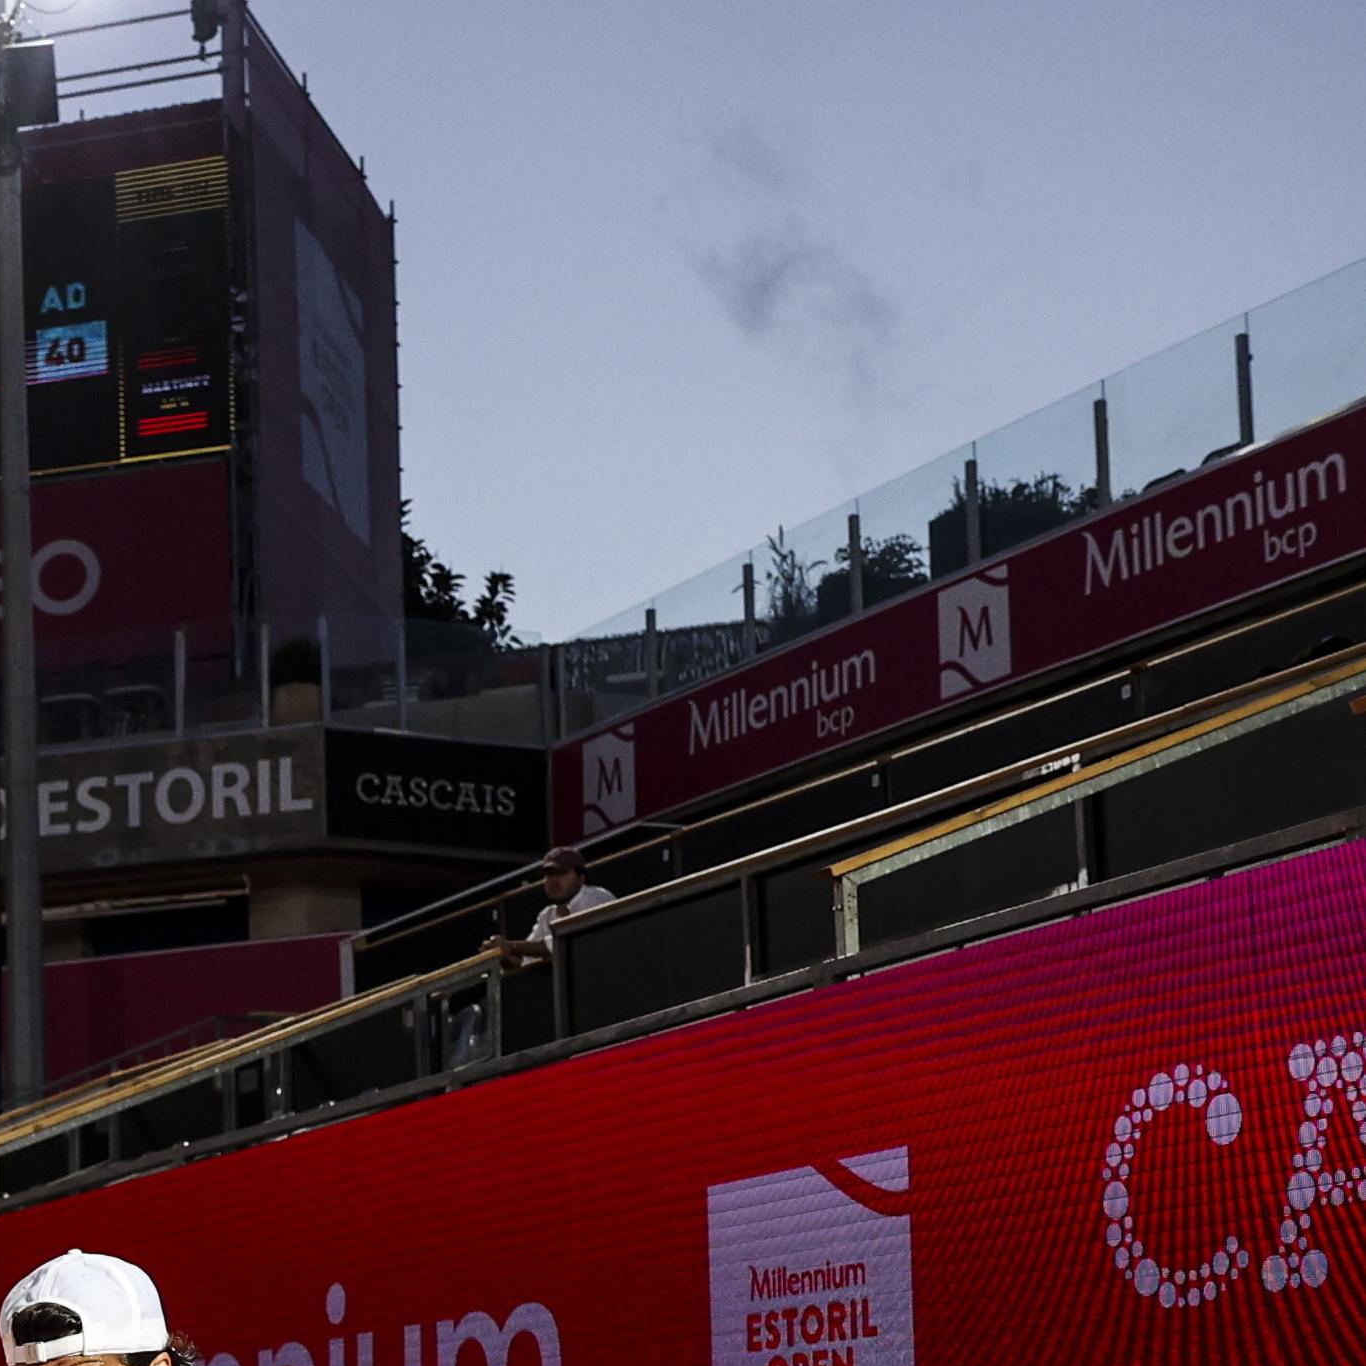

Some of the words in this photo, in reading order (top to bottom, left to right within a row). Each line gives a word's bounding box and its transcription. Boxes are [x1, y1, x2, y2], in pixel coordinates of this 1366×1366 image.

[40, 281, 87, 313] AD
[43, 336, 87, 366] 40
[1082, 452, 1348, 597] Millennium
[1263, 517, 1319, 563] bcp
[957, 605, 993, 659] M
[688, 649, 877, 755] Millennium
[817, 705, 855, 738] bcp
[38, 755, 313, 838] ESTORIL
[355, 772, 517, 817] CASCAIS
[597, 755, 623, 801] M
[749, 1260, 866, 1302] Millennium
[747, 1296, 879, 1353] ESTORIL
